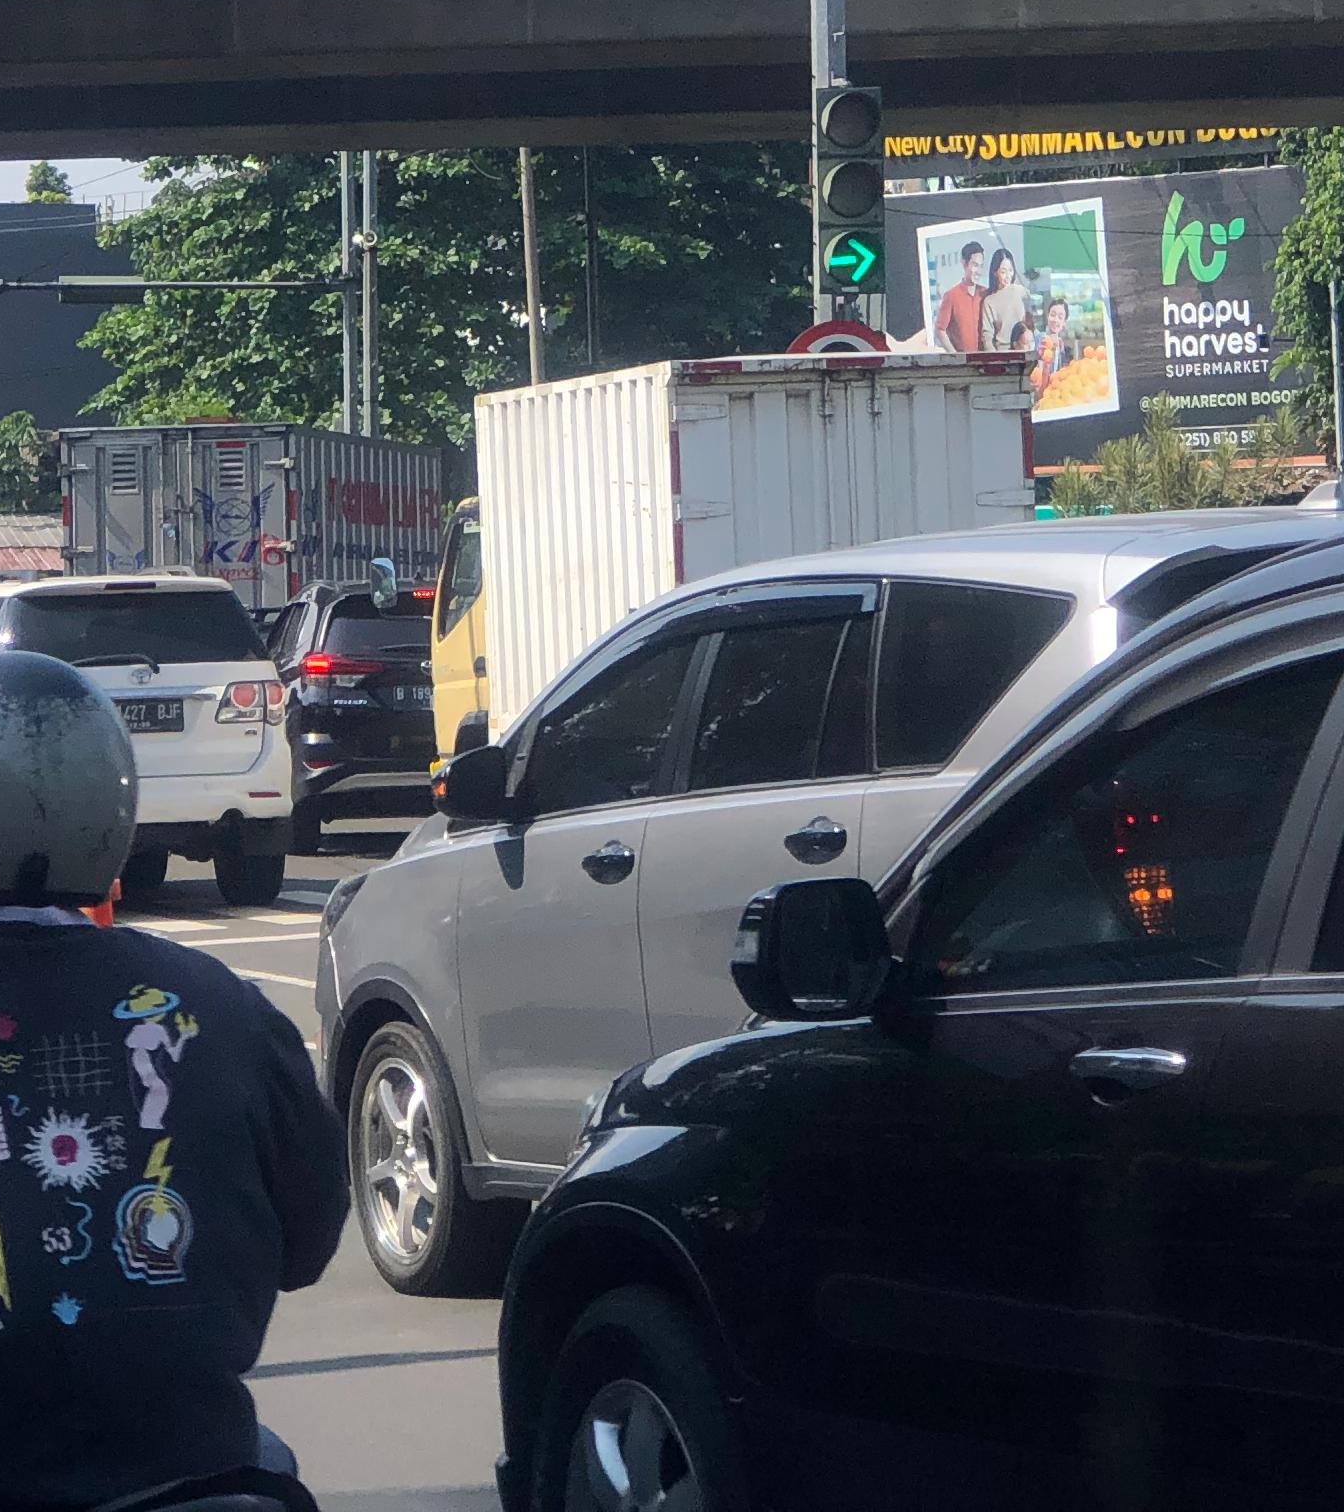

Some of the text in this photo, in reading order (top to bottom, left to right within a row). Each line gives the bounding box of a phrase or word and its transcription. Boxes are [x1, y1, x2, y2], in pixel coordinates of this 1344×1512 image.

[885, 136, 931, 157] New
[1163, 296, 1250, 329] happy
[1164, 323, 1270, 358] harvest
[1166, 359, 1269, 378] SUPERMARKET
